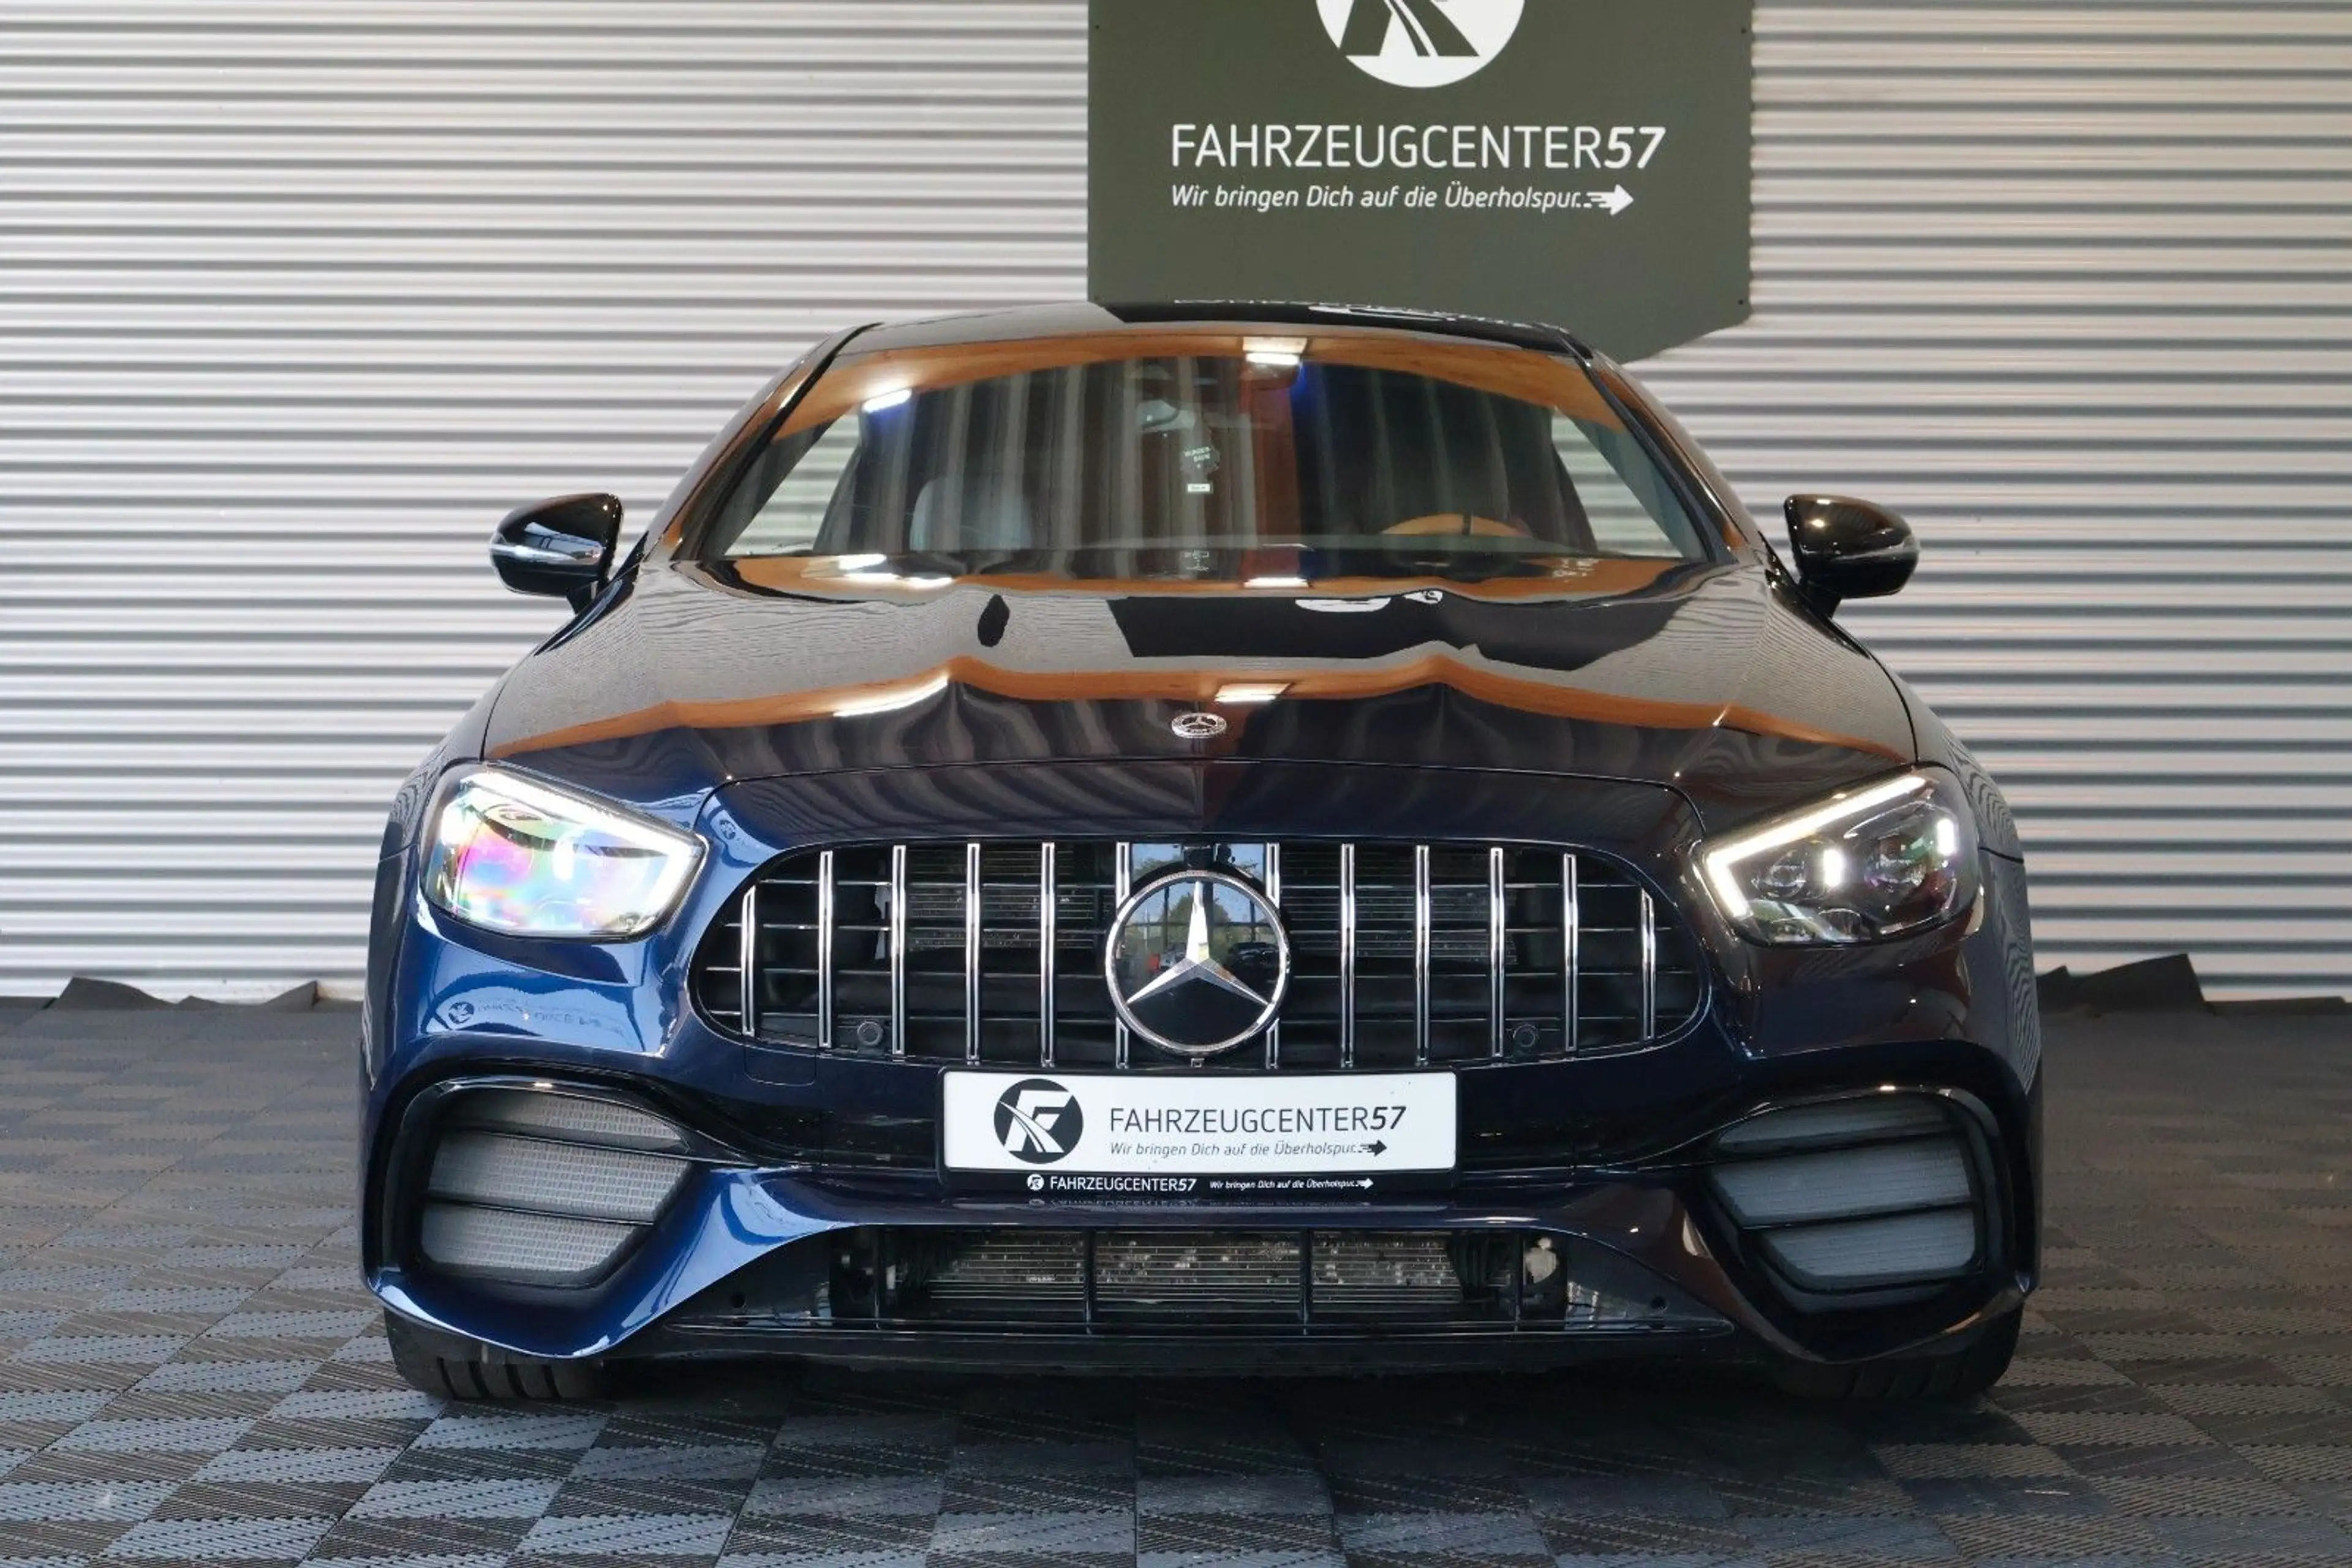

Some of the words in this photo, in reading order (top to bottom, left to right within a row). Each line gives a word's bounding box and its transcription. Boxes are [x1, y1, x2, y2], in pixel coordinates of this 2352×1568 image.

[1172, 123, 1667, 170] FAHRZEUGCENTER57
[1172, 184, 1210, 207] Wir
[1214, 184, 1300, 213] bringen
[1306, 184, 1354, 208] Dich
[1360, 184, 1401, 208] auf
[1404, 185, 1439, 208] die
[1110, 1106, 1407, 1133] FAHRZEUGCENTER57
[1110, 1142, 1132, 1155] Wir
[1136, 1142, 1187, 1158] bringen
[1191, 1143, 1220, 1155] Dich
[1224, 1143, 1247, 1155] auf
[1250, 1143, 1270, 1155] die
[1050, 1175, 1197, 1192] FAHRZEUGCENTER57
